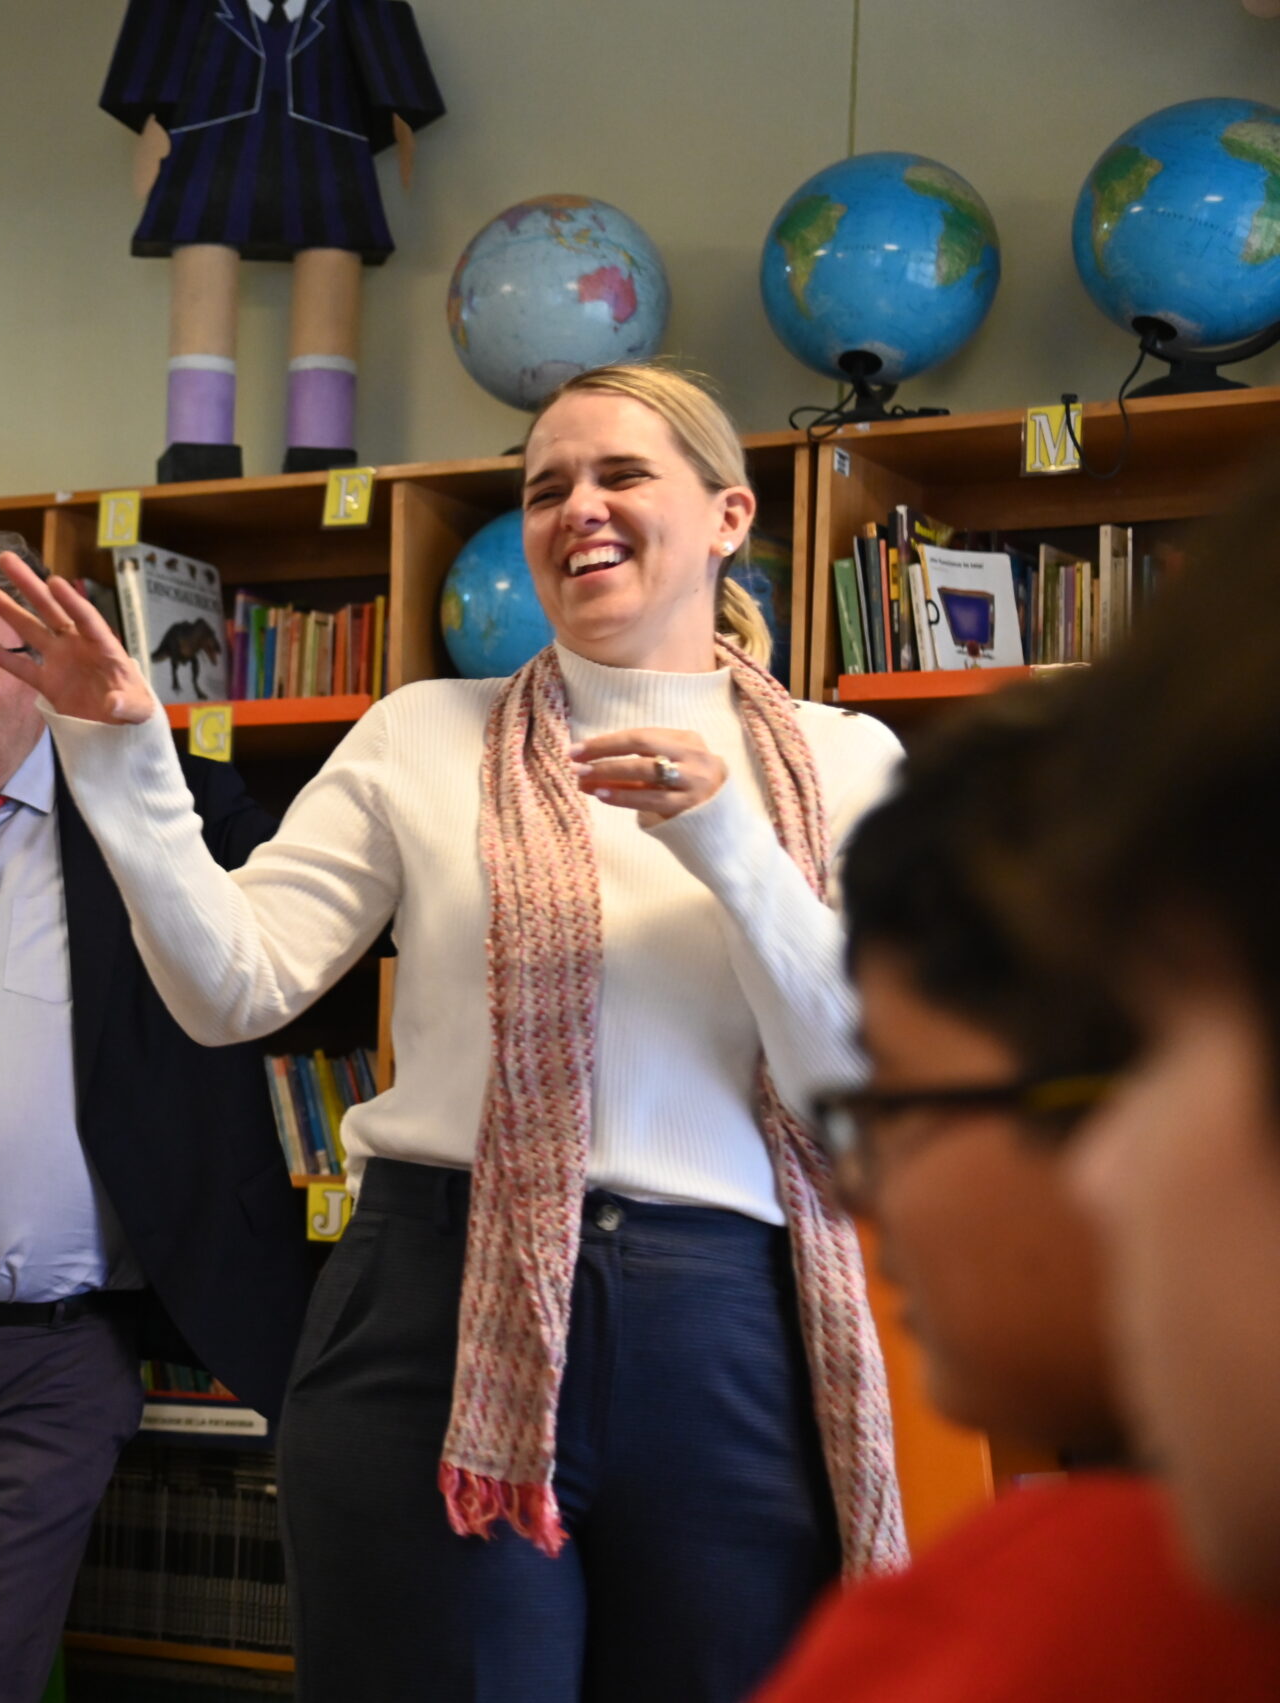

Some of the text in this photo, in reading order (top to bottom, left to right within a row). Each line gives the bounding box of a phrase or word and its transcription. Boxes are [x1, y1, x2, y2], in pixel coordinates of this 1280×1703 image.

[1030, 412, 1081, 469] M
[105, 497, 134, 541] E
[332, 474, 367, 519] F
[194, 711, 229, 752] G
[312, 1189, 347, 1236] J
